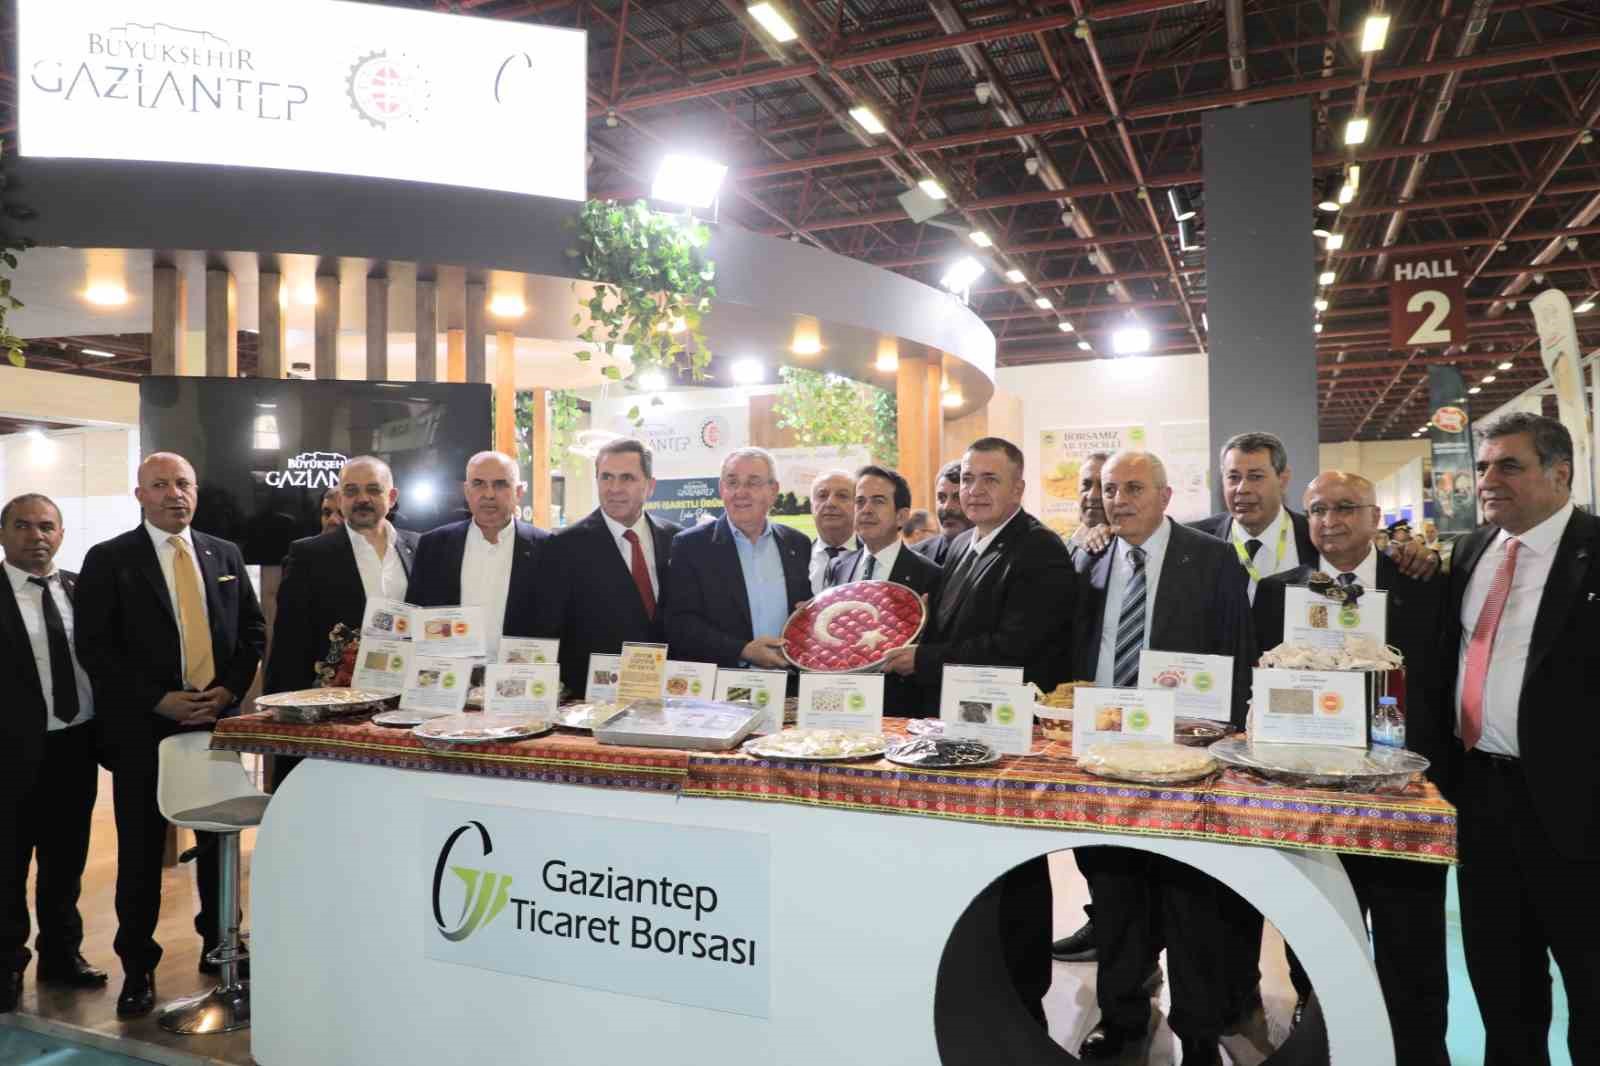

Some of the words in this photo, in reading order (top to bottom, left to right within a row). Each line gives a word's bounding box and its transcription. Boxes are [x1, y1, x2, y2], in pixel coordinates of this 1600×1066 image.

[1394, 259, 1459, 281] HALL
[1406, 290, 1452, 345] 2
[265, 469, 341, 488] GAZİAN
[288, 458, 345, 470] BÜYÜKŞEH
[541, 859, 718, 921] Gaziantep
[510, 897, 620, 945] Ticaret
[631, 916, 756, 965] Borsası
